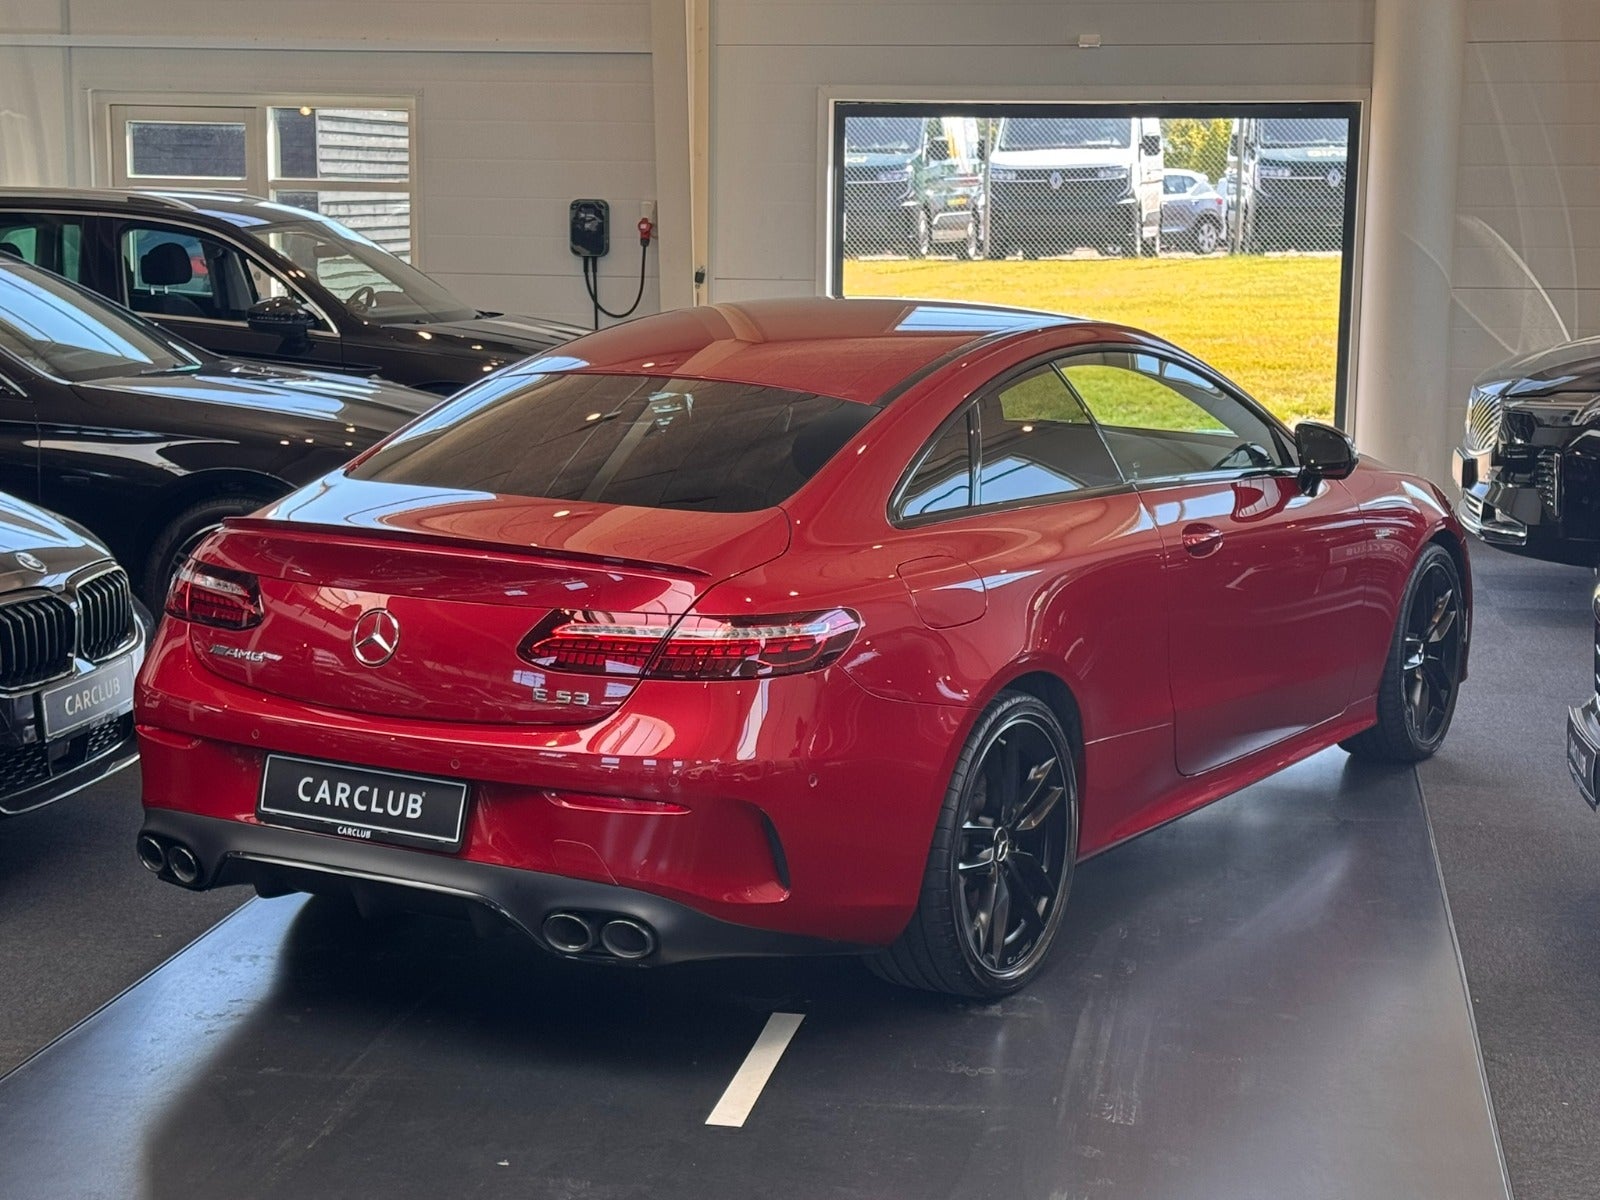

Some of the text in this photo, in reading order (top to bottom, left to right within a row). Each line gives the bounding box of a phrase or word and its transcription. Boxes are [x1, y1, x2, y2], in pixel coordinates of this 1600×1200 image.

[222, 647, 267, 662] AMG
[65, 677, 121, 716] CARCLUB
[533, 687, 589, 705] E 53
[297, 776, 424, 819] CARCLUB
[337, 826, 371, 839] CARCLUB
